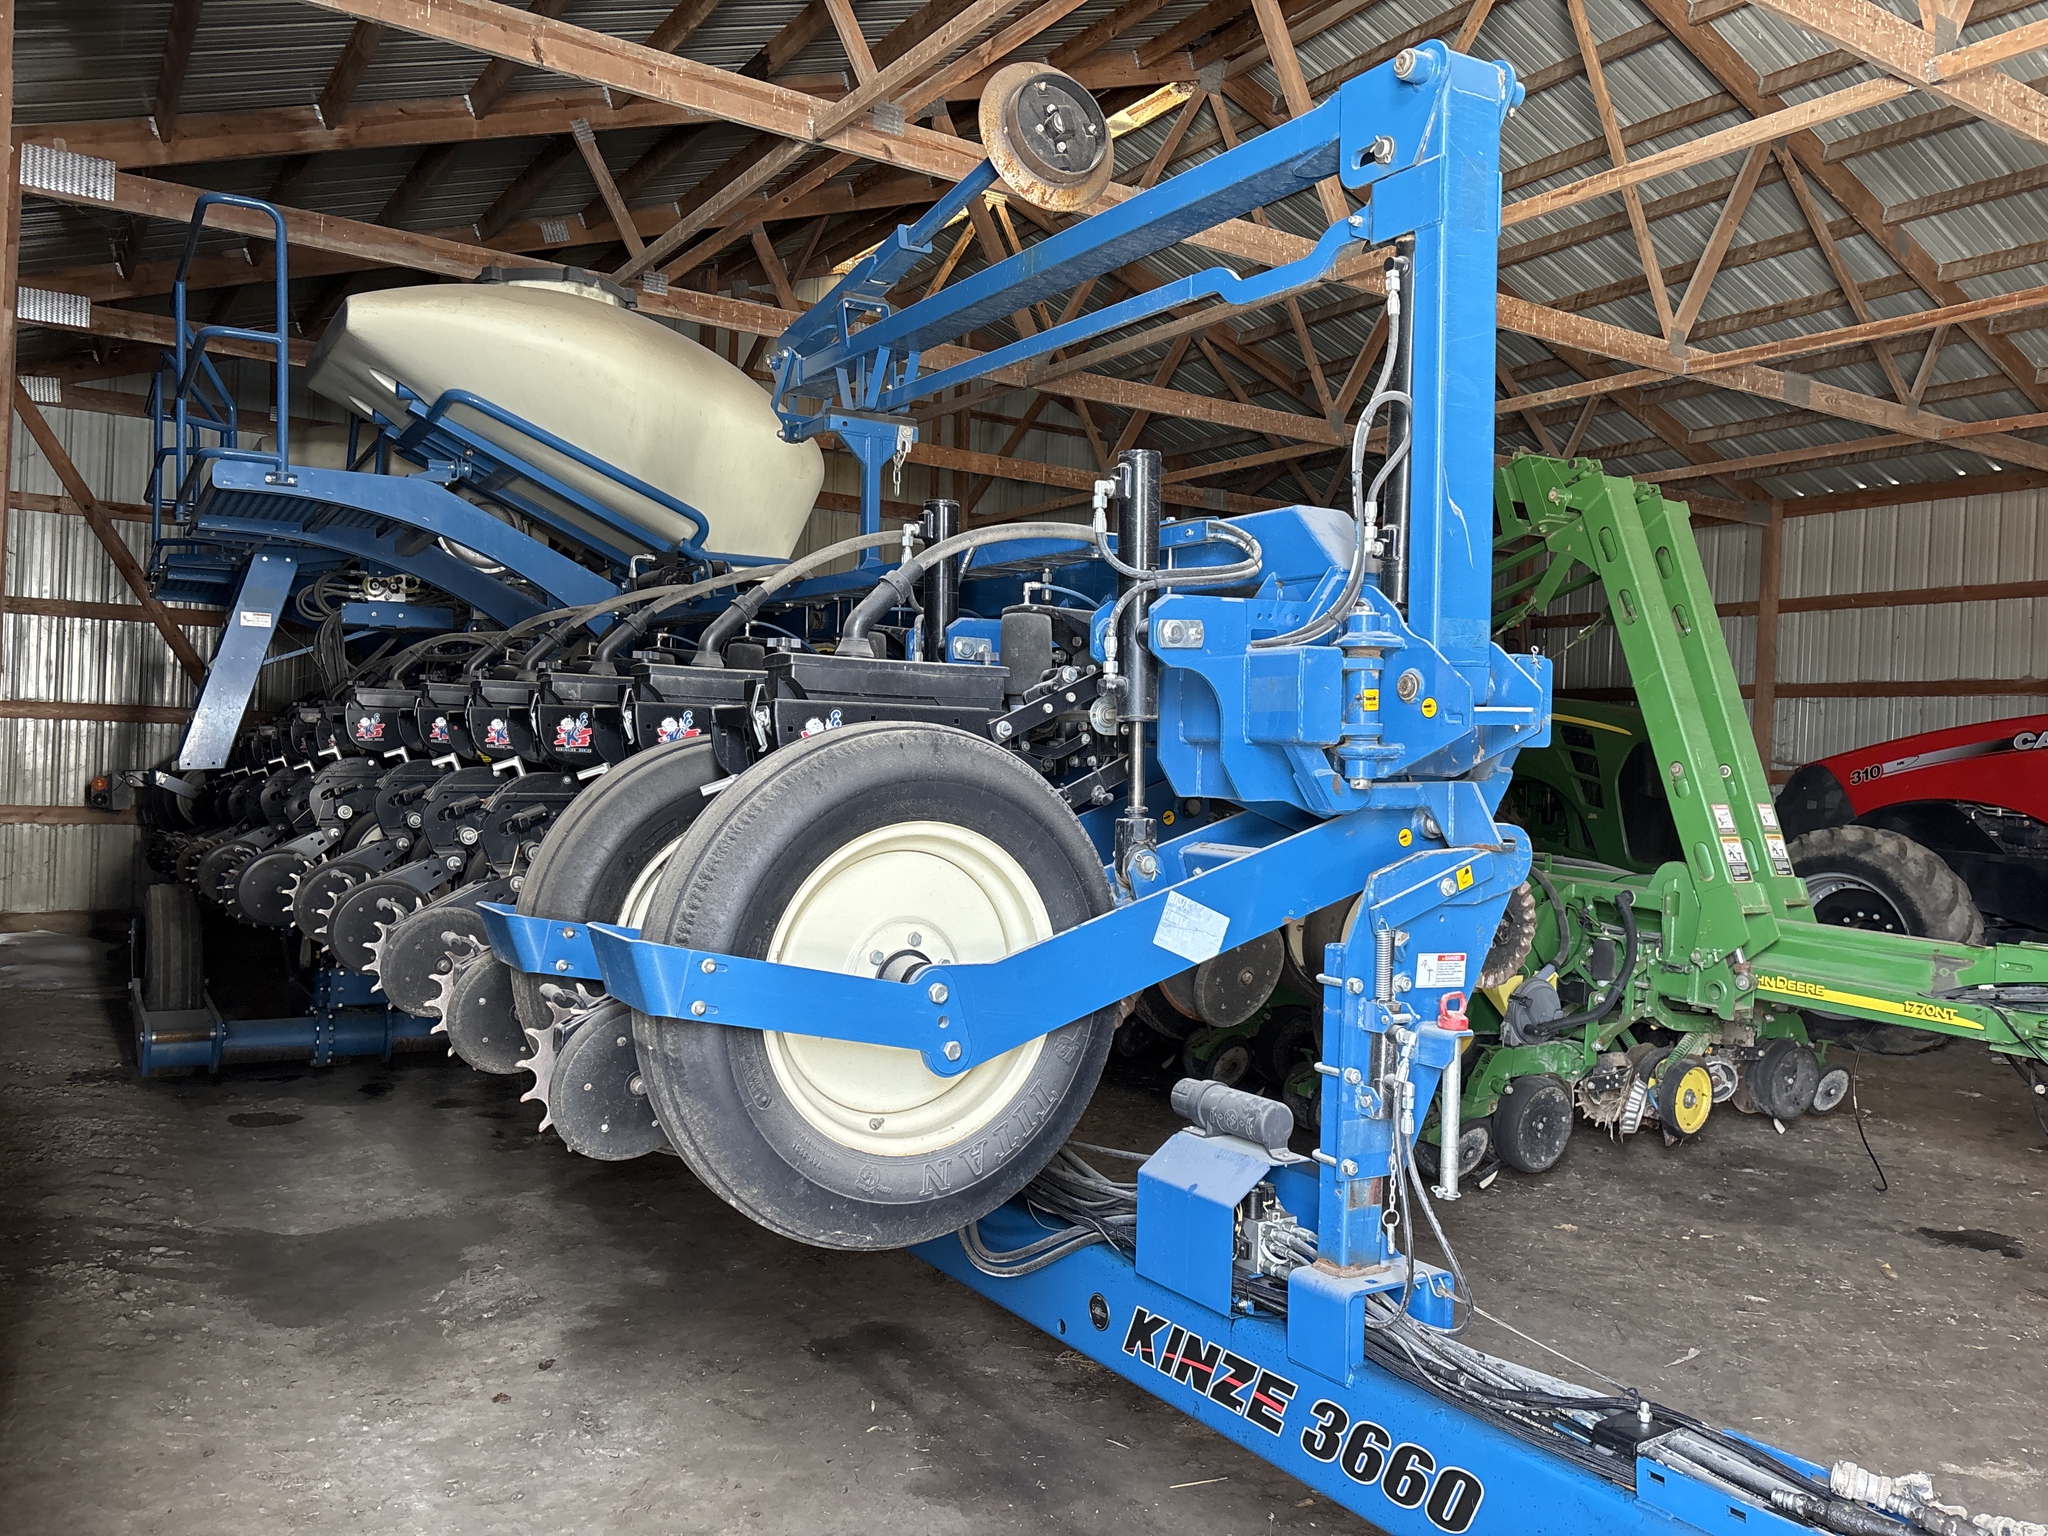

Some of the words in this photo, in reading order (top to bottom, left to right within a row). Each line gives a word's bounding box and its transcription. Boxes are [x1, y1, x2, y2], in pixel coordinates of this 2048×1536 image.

[1849, 764, 1882, 785] 310
[1775, 975, 1825, 996] DEERE
[1903, 1000, 1959, 1022] 1770NT
[919, 1078, 1059, 1197] TITAN
[1122, 1305, 1299, 1437] KINZE
[1300, 1398, 1485, 1535] 3660
